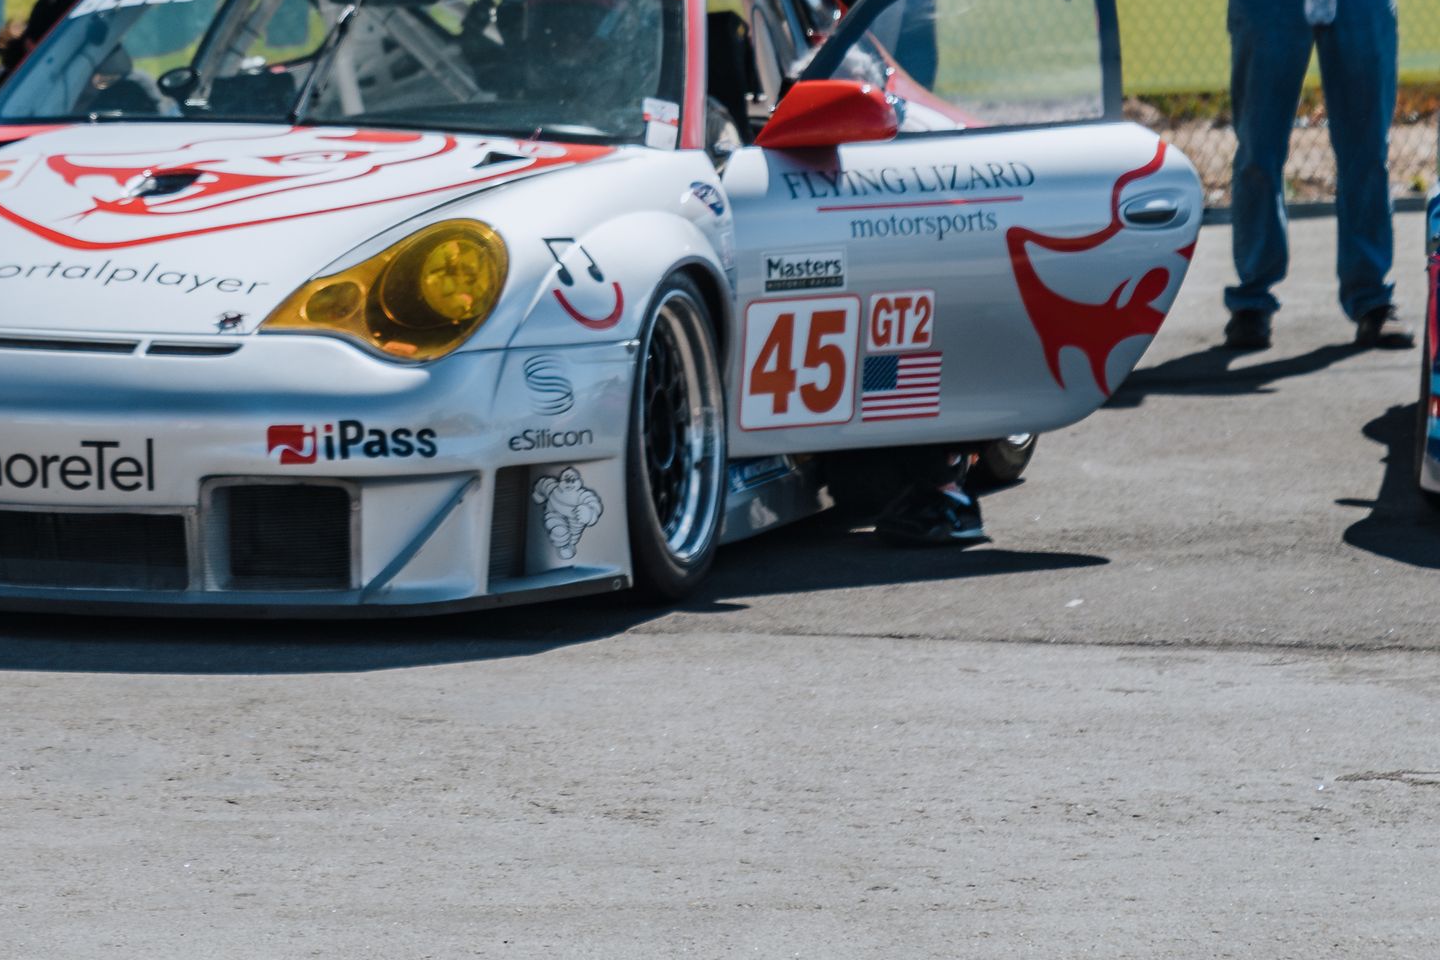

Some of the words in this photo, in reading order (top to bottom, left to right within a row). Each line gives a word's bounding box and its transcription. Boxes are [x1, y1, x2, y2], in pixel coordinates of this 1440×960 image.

[782, 167, 907, 200] FLYING
[911, 161, 1036, 192] LIZARD
[849, 209, 999, 241] motorsports
[766, 257, 843, 279] Masters
[871, 295, 932, 348] GT2
[749, 309, 848, 415] 45
[323, 420, 439, 461] iPass
[508, 427, 594, 453] eSilicon
